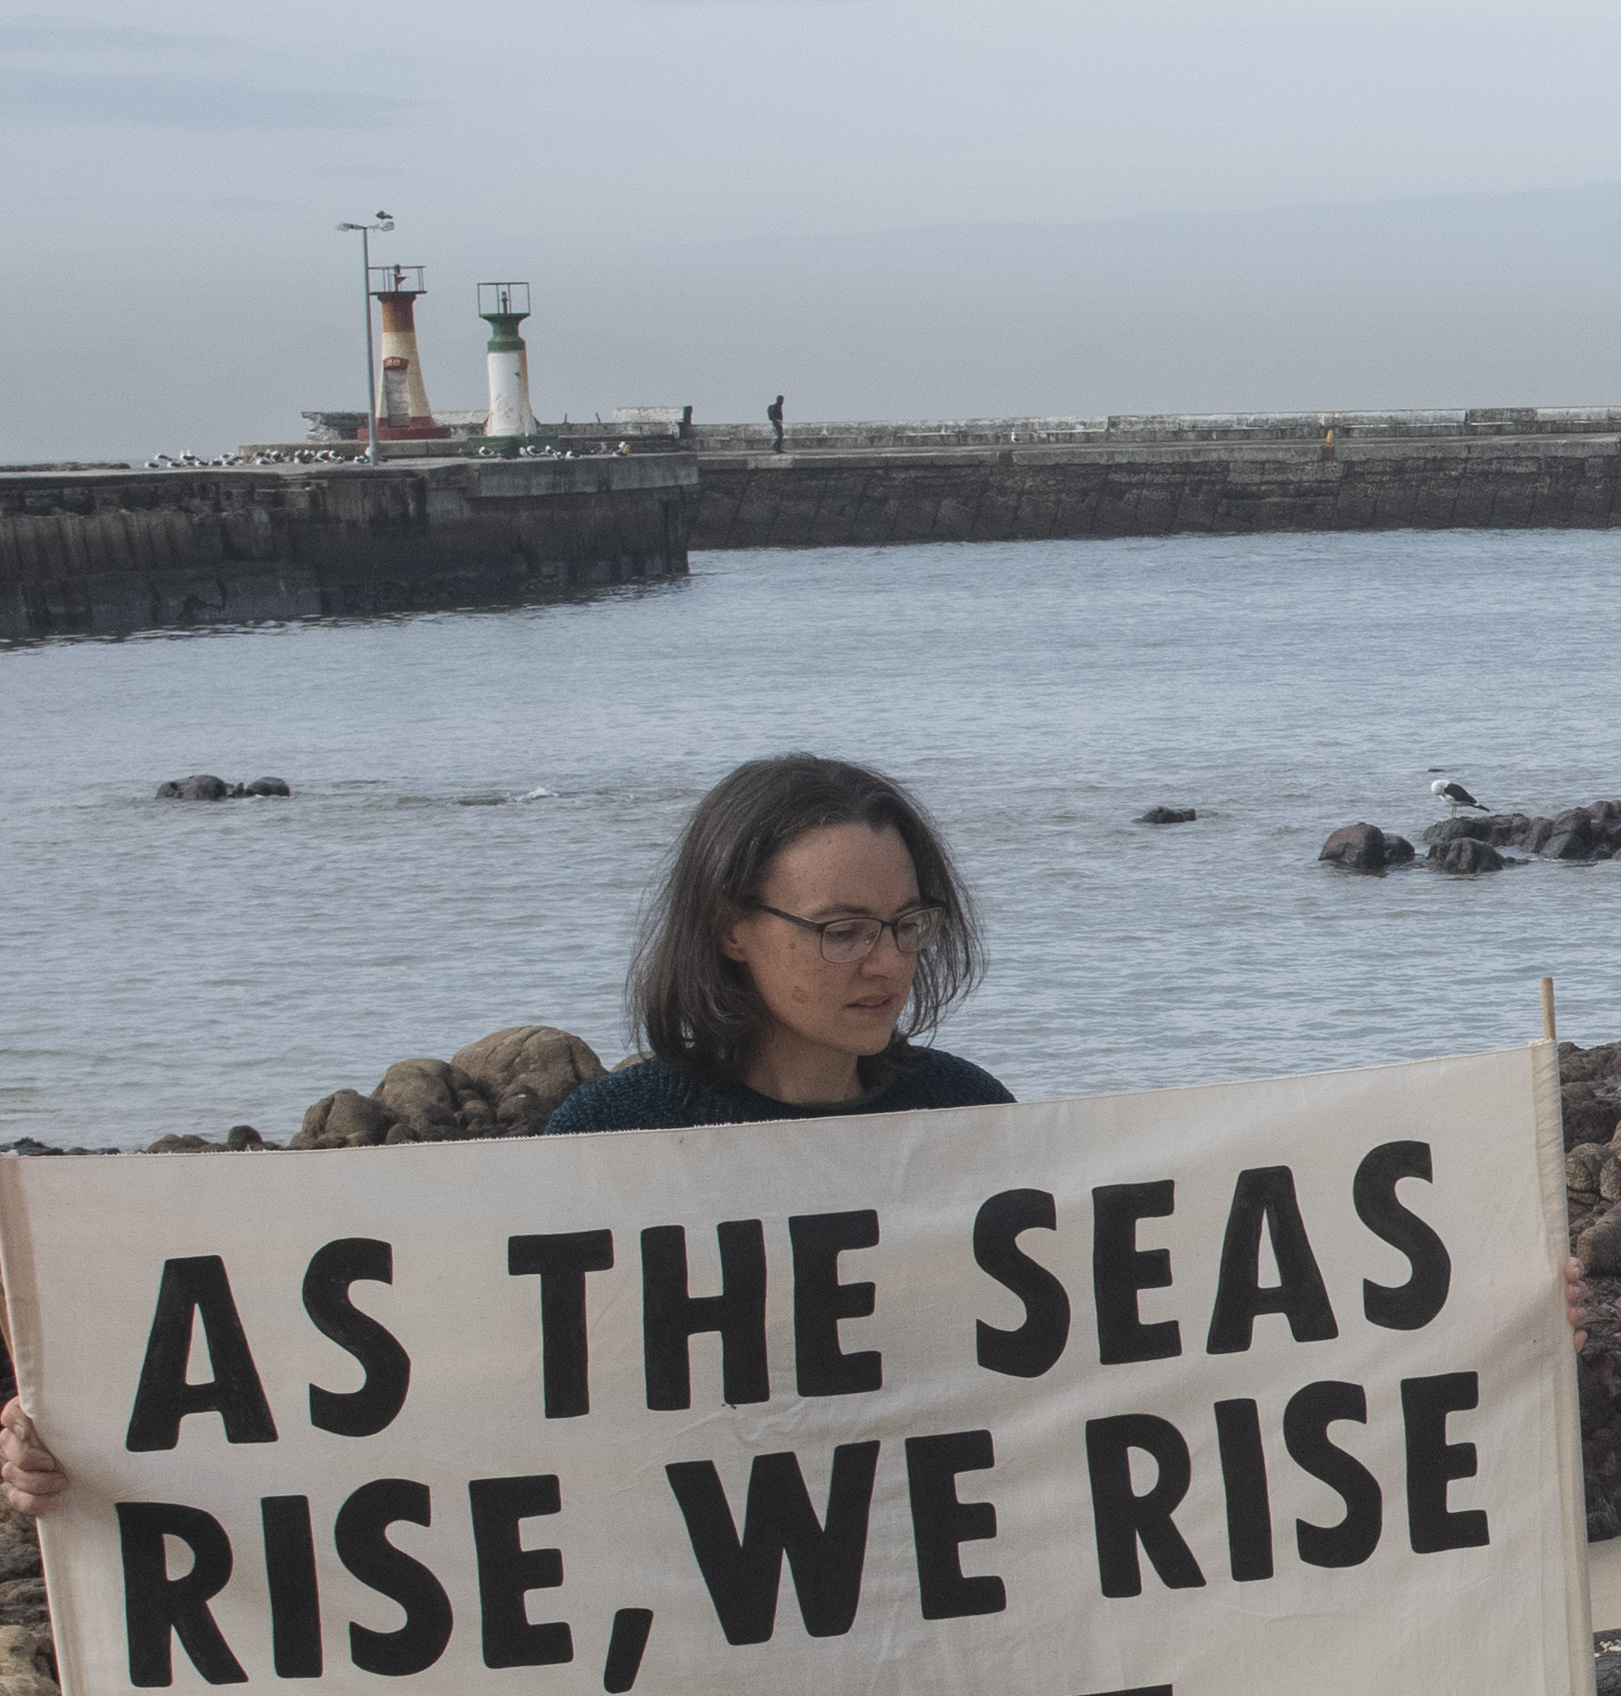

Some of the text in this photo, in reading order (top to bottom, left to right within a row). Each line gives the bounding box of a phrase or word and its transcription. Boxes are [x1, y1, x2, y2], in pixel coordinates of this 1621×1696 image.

[125, 1140, 1451, 1453] AS THE SEAS
[113, 1371, 1490, 1694] RISE, WE RISE
